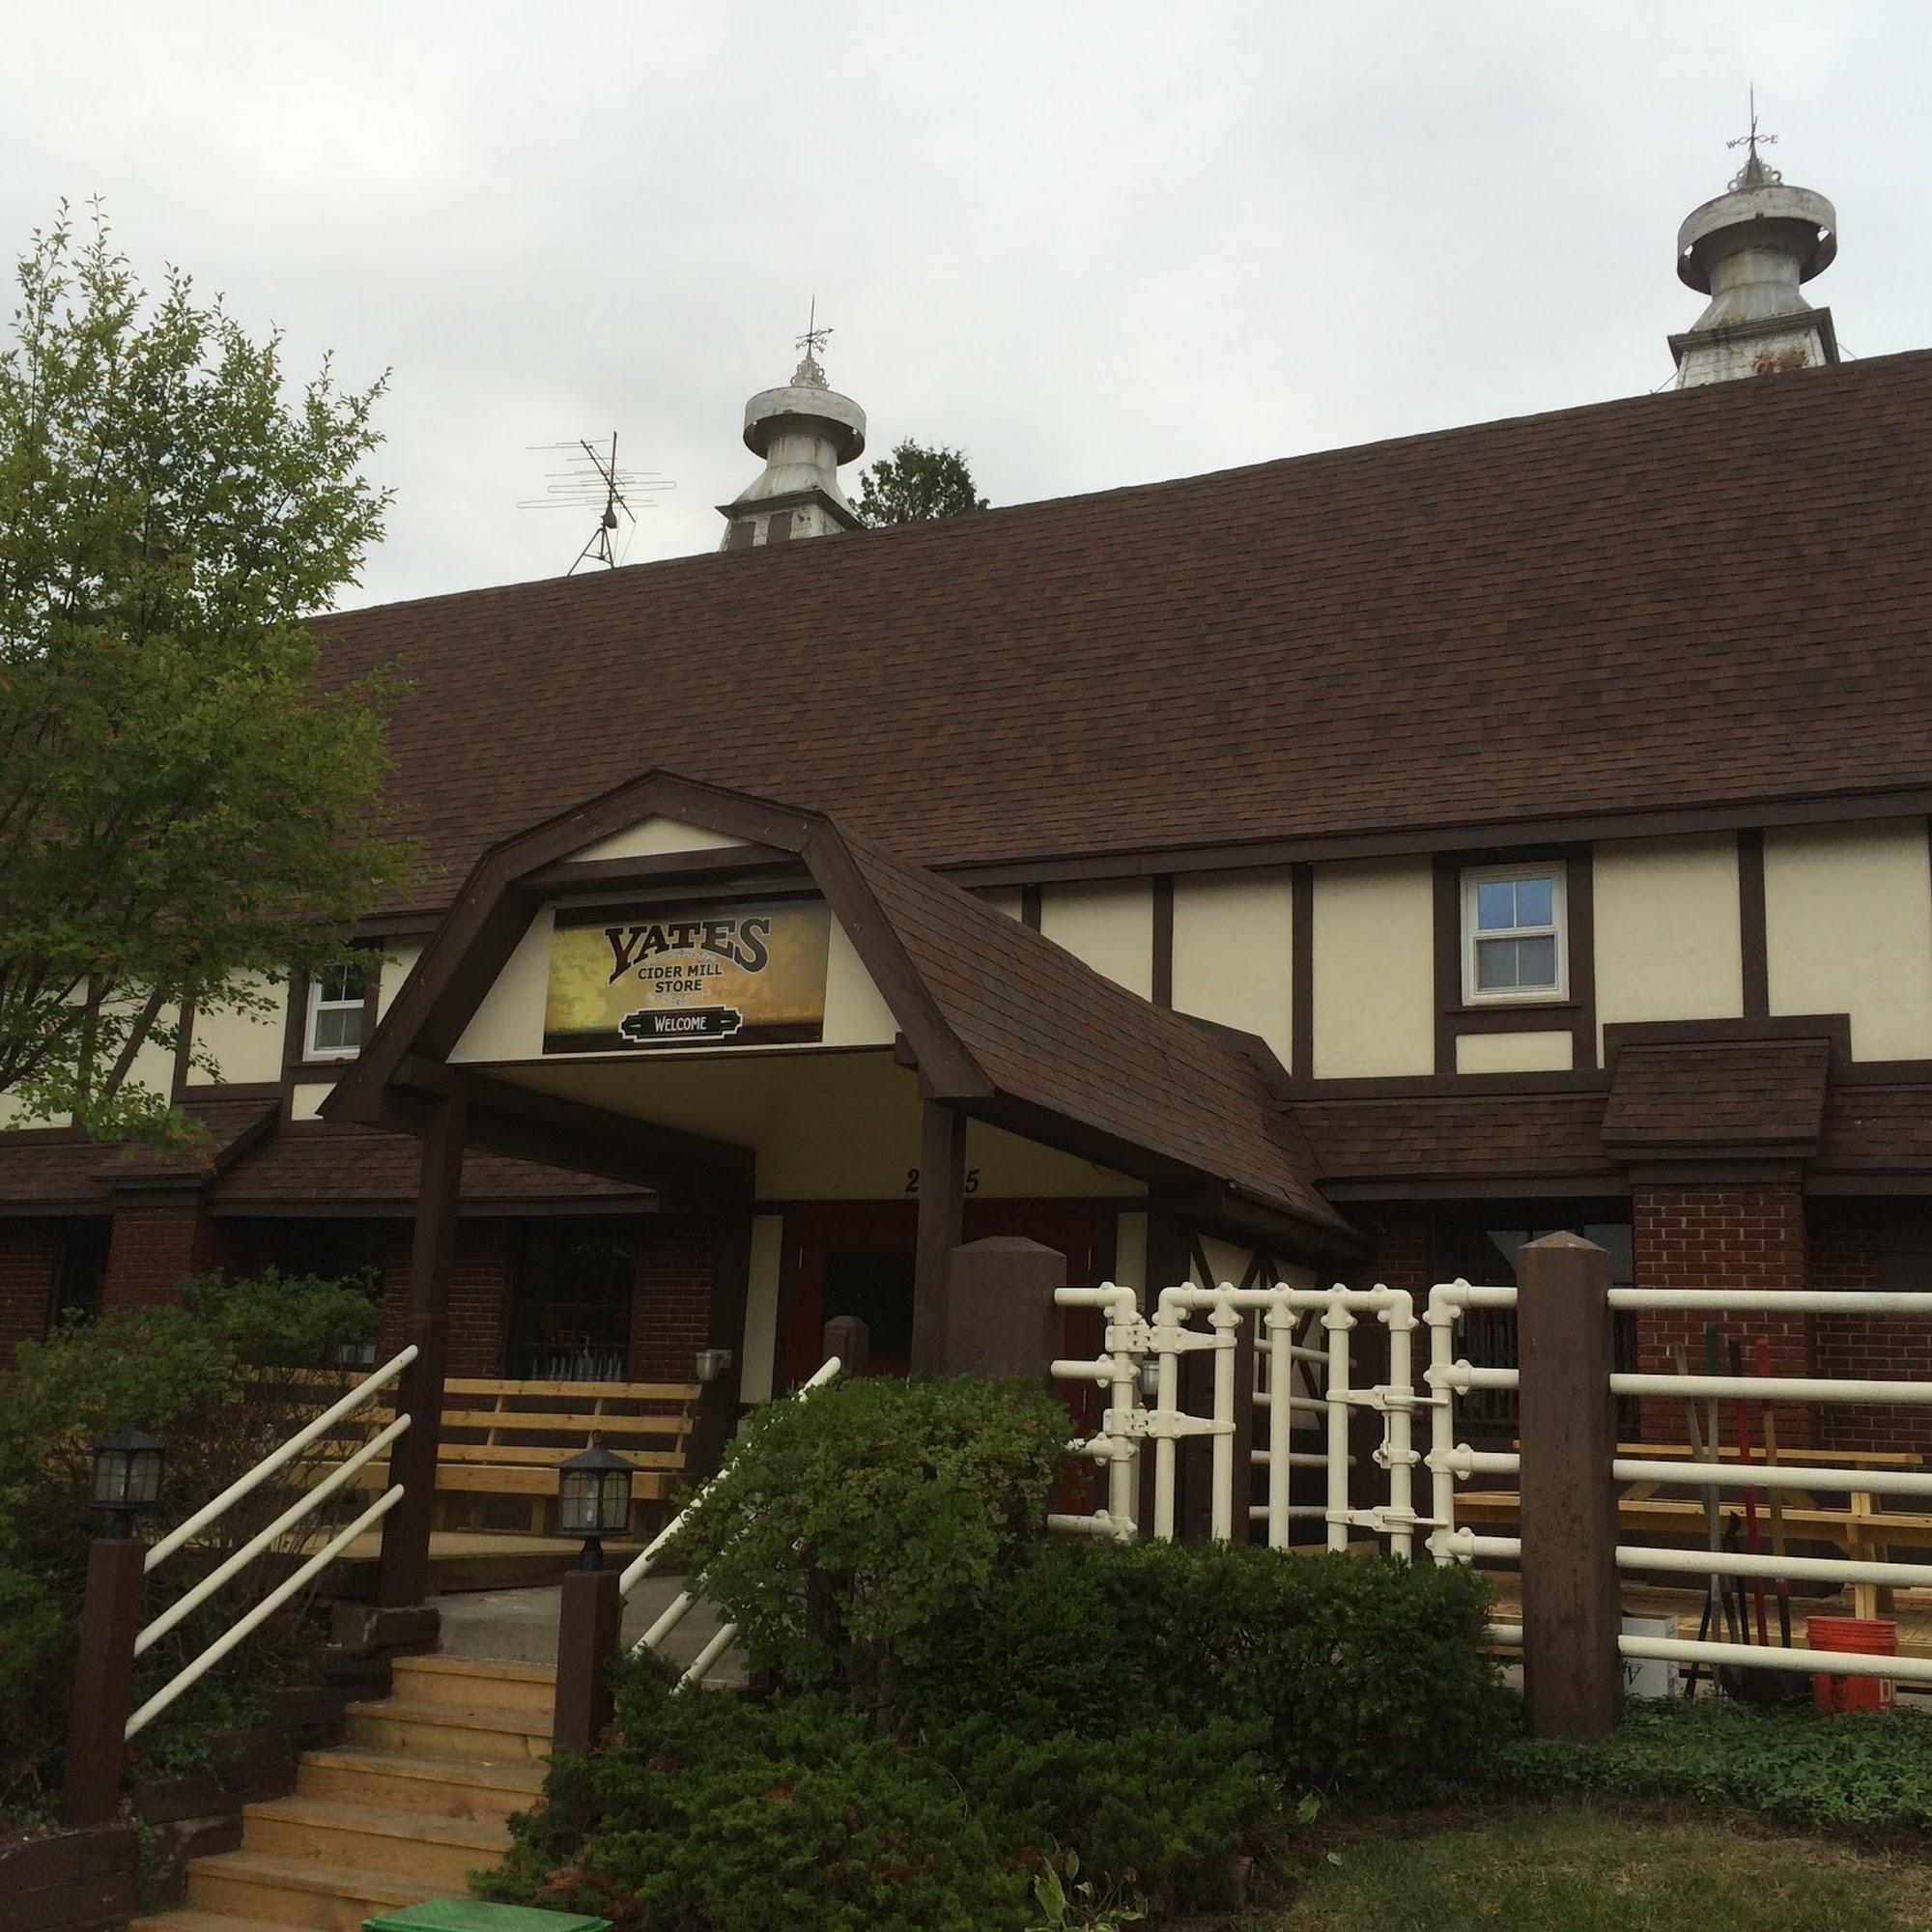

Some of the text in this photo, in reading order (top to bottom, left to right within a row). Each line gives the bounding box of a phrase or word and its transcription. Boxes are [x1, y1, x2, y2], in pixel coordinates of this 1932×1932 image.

[605, 918, 770, 984] YATES
[638, 964, 723, 980] CIDER MILL
[655, 980, 702, 993] STORE
